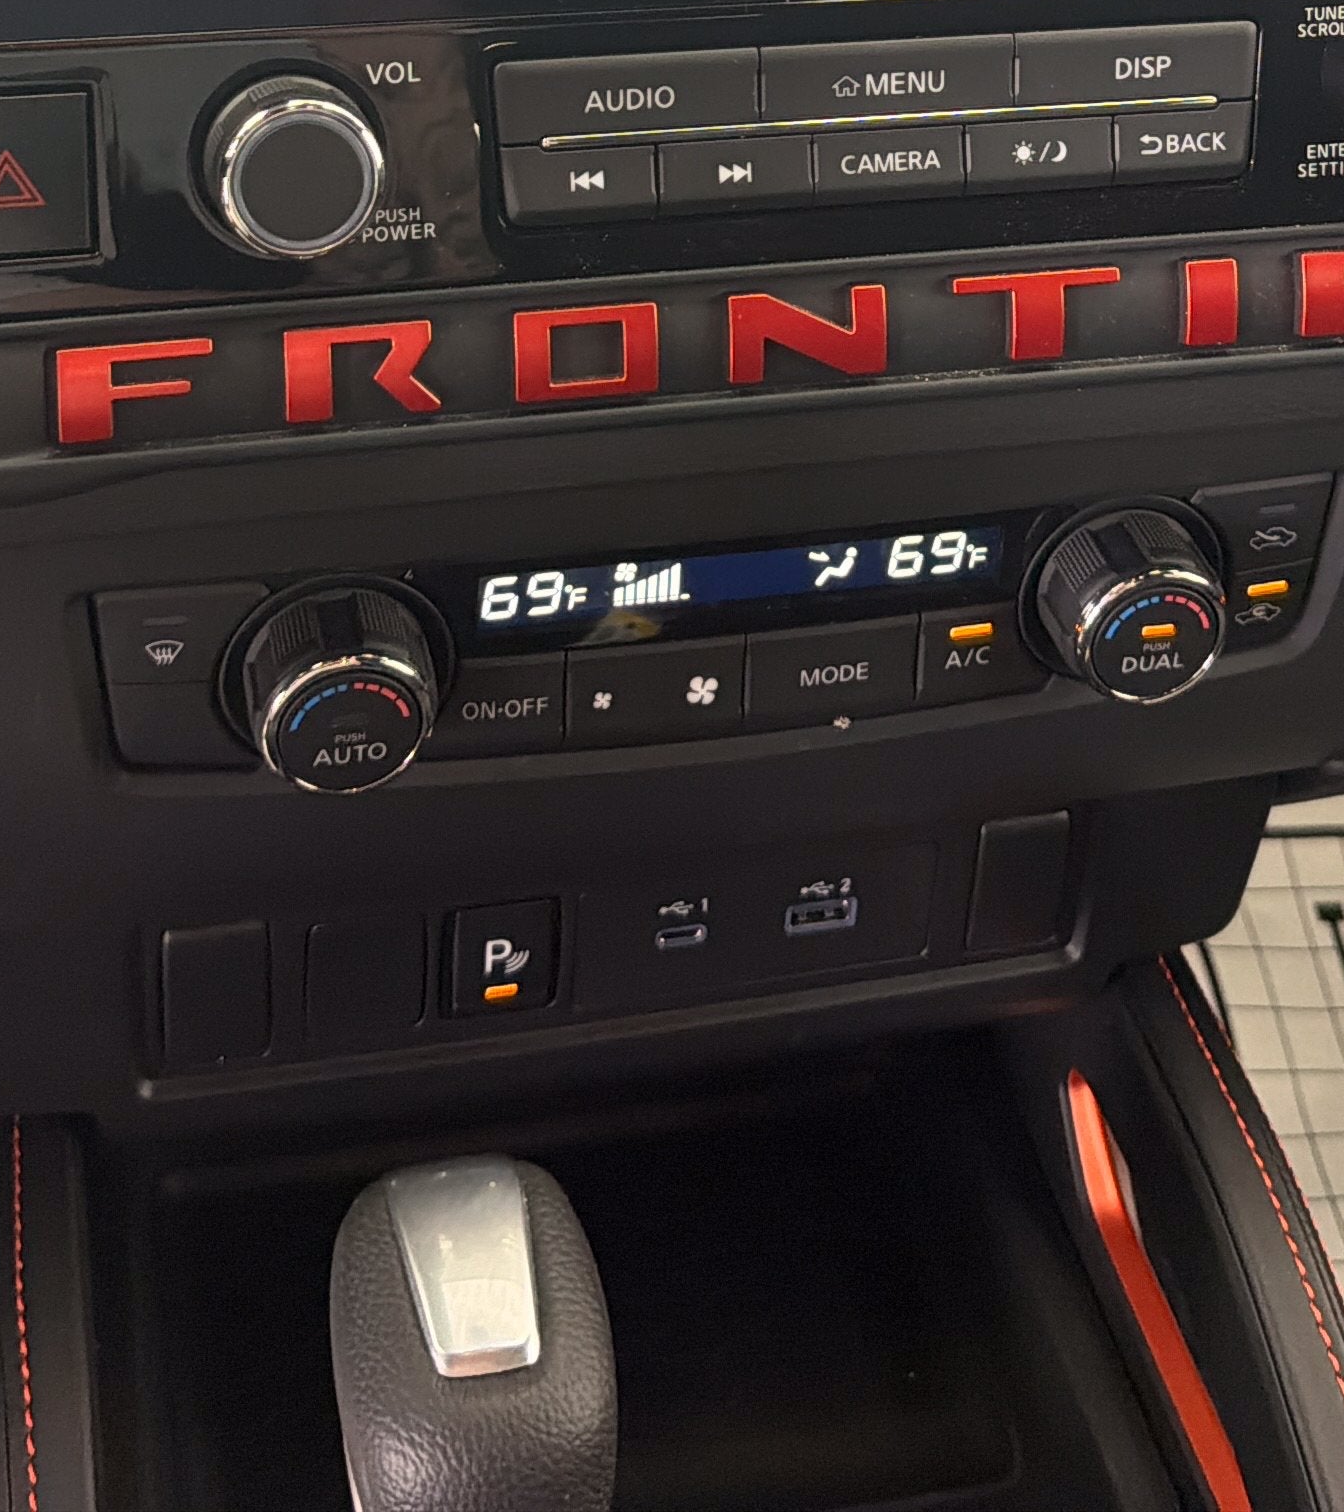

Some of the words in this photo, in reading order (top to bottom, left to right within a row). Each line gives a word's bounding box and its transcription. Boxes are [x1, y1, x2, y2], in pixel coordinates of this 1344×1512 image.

[366, 61, 422, 86] VOL
[1114, 56, 1172, 80] DISP
[865, 70, 946, 97] MENU
[584, 86, 676, 113] AUDIO
[1166, 132, 1227, 155] BACK
[840, 150, 941, 175] CAMERA
[374, 207, 422, 225] PUSH
[361, 222, 437, 245] POWER
[944, 645, 991, 670] A/C
[1142, 641, 1171, 652] PUSH
[799, 661, 869, 687] MODE
[1121, 652, 1184, 675] DUAL
[334, 732, 367, 744] PUSH
[312, 742, 387, 768] AUTO
